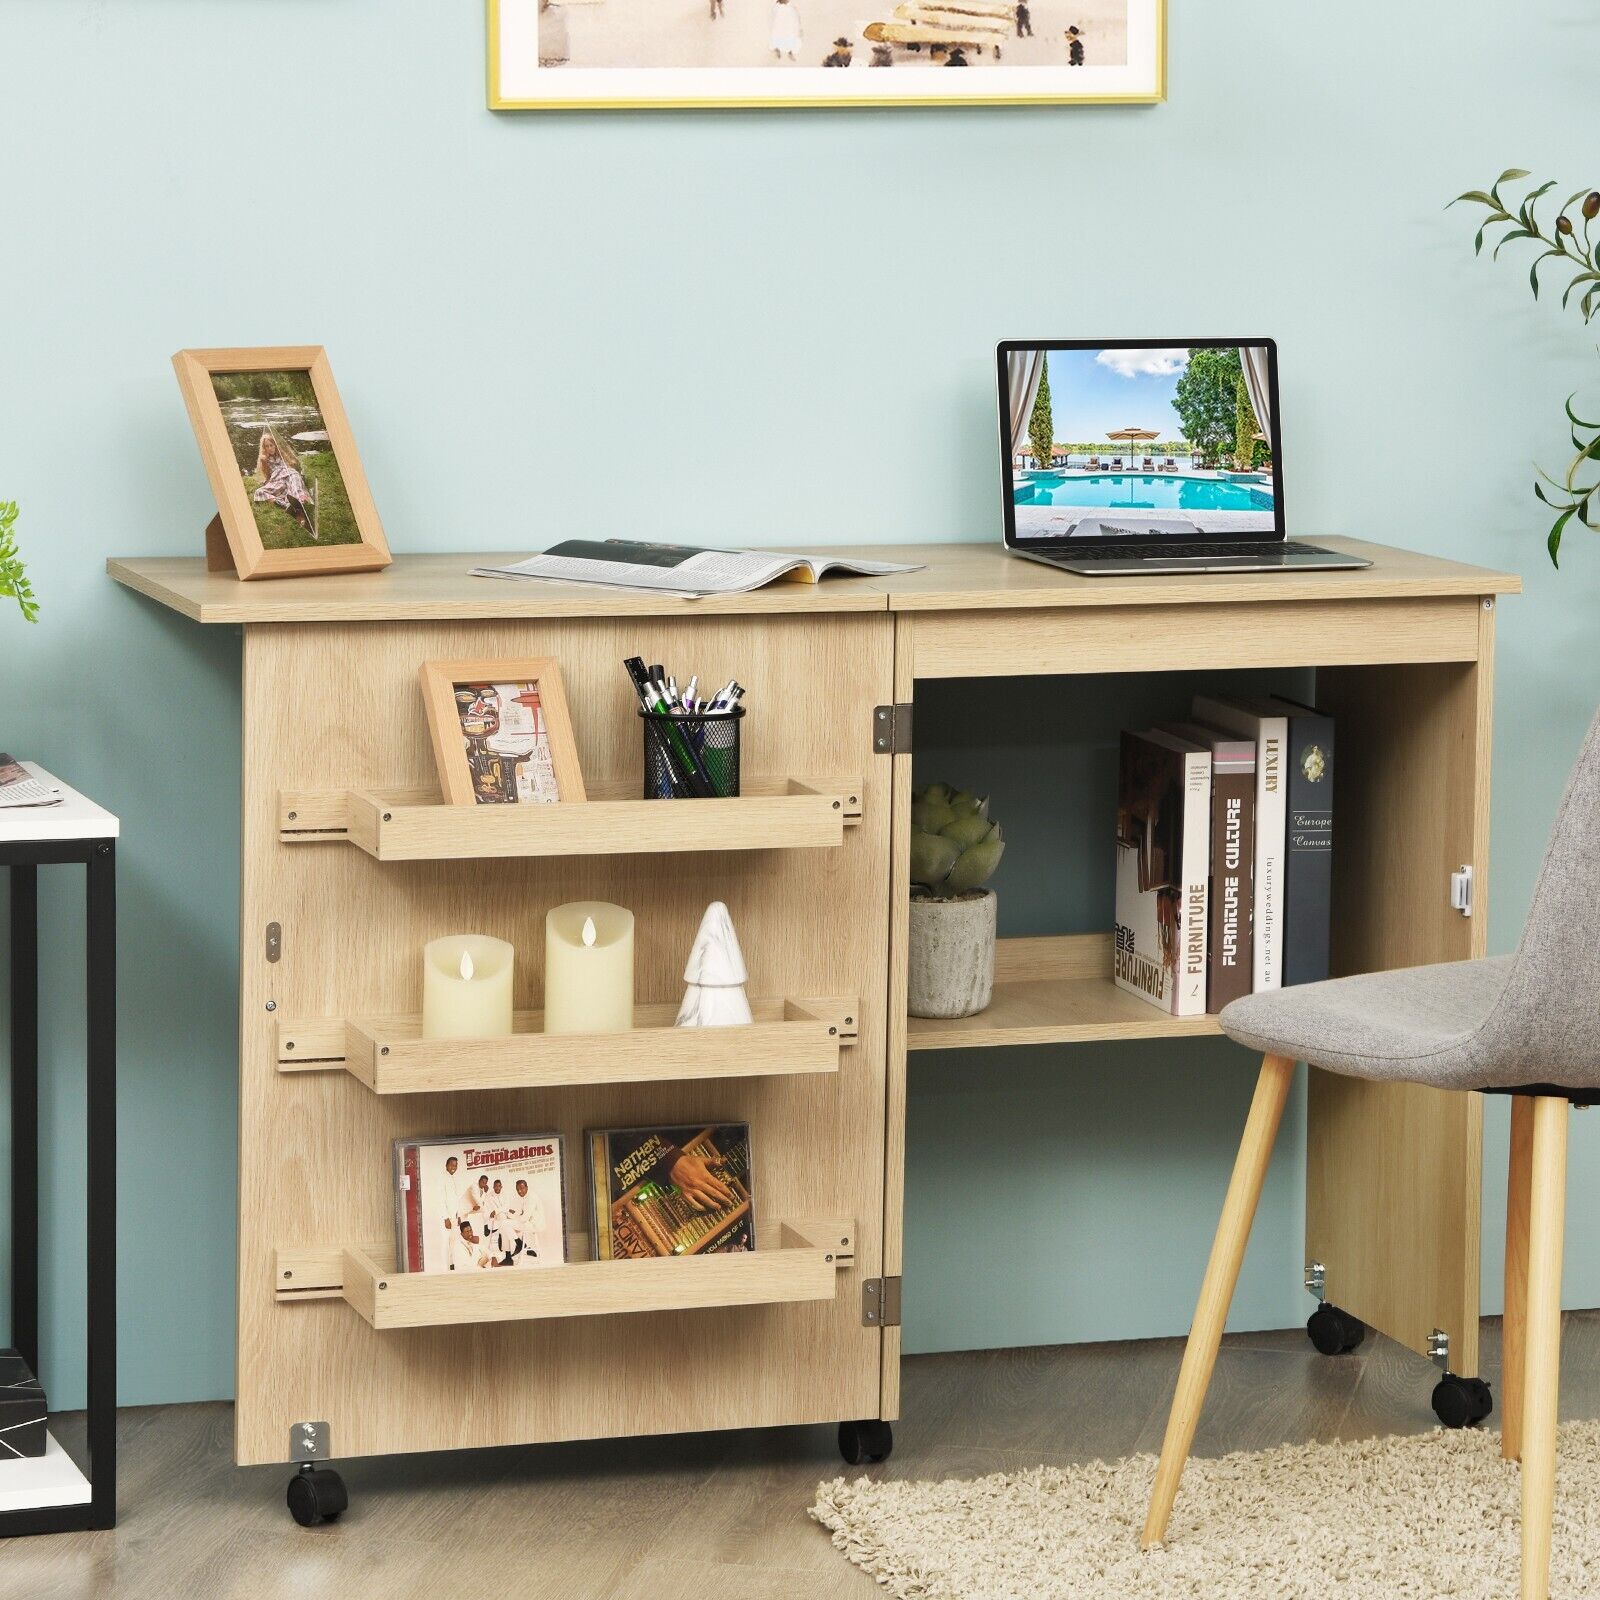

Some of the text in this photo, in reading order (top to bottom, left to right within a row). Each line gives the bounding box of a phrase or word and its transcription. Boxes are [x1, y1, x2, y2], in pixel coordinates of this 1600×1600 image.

[1265, 739, 1279, 794] LUXURY
[1293, 835, 1332, 847] Canvas
[1294, 815, 1332, 829] Europe
[1187, 884, 1205, 974] FURNITURE
[1115, 948, 1165, 1000] FURNITURE
[463, 1144, 554, 1168] Temptations
